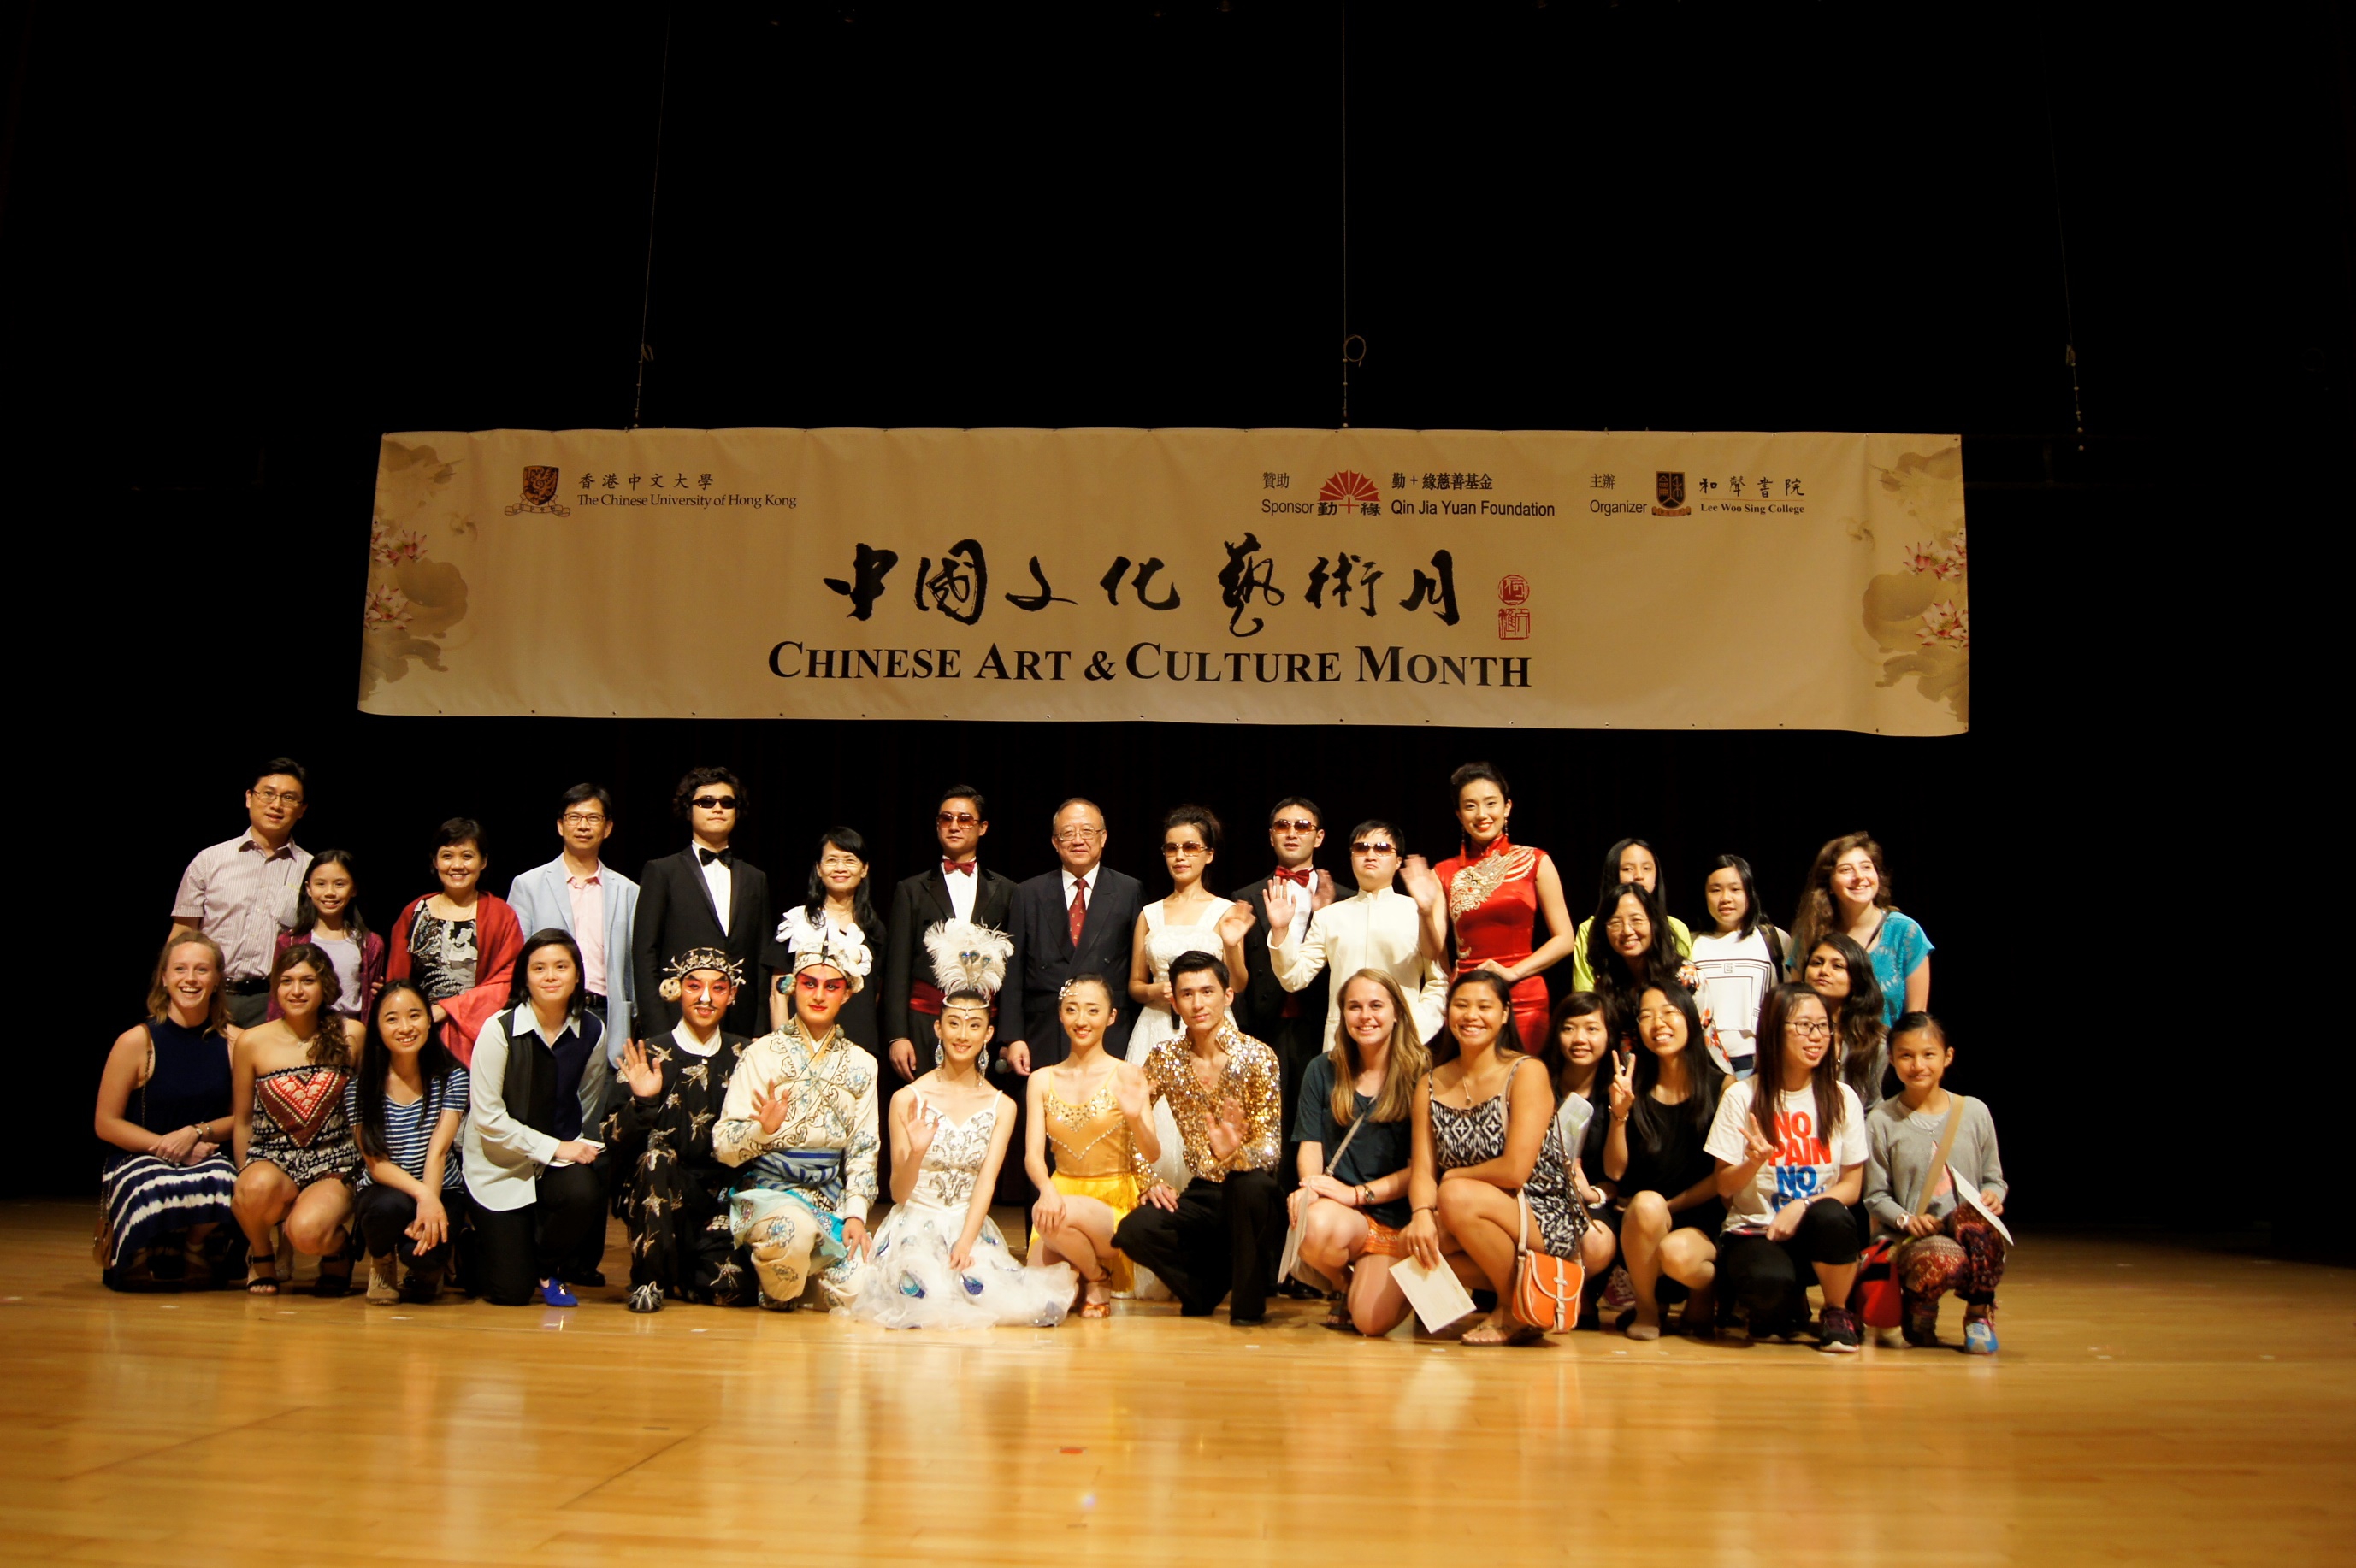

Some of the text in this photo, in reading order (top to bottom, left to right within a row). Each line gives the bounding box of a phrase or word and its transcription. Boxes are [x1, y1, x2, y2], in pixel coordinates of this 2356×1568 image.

[578, 472, 715, 492] 香港中文大學
[1589, 473, 1615, 491] 主辦
[1698, 475, 1805, 498] 和聲書院
[577, 493, 797, 510] The Chinese University of Hong Kong
[1261, 498, 1314, 517] Sponsor
[1391, 498, 1556, 518] Qin Jia Yuan Foundation
[1589, 498, 1648, 518] Organizer
[1700, 503, 1718, 513] Lee
[1721, 503, 1742, 513] Woo
[1744, 504, 1767, 516] Sing
[1768, 504, 1805, 515] College
[823, 531, 1461, 640] 中國文化藝術月
[768, 640, 1532, 687] CHINESE ART & CULTURE MONTH
[1774, 1111, 1812, 1139] NO
[1768, 1137, 1832, 1166] PAIN
[1776, 1165, 1817, 1194] NO
